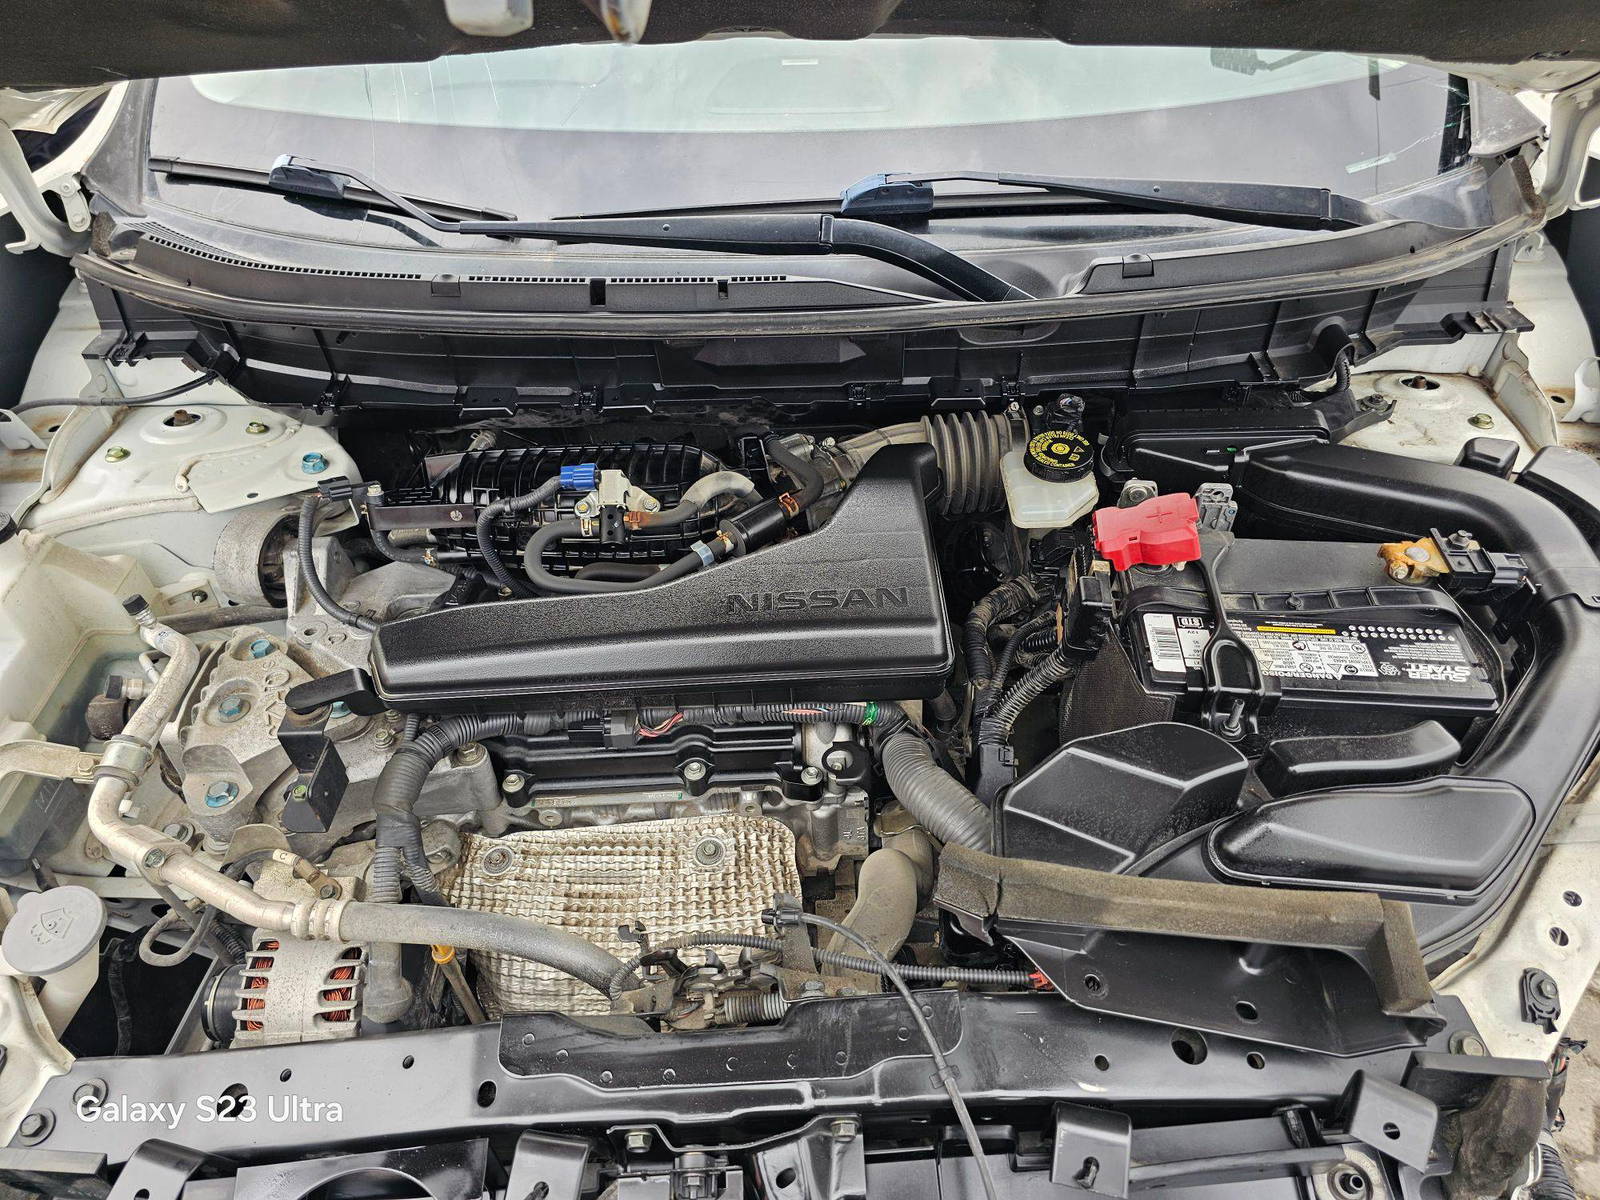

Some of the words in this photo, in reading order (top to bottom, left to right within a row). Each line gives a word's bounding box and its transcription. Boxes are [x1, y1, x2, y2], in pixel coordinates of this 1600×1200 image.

[727, 587, 909, 614] NISSAN
[1262, 670, 1333, 679] DANGER/POISO
[1408, 670, 1468, 683] SUPER
